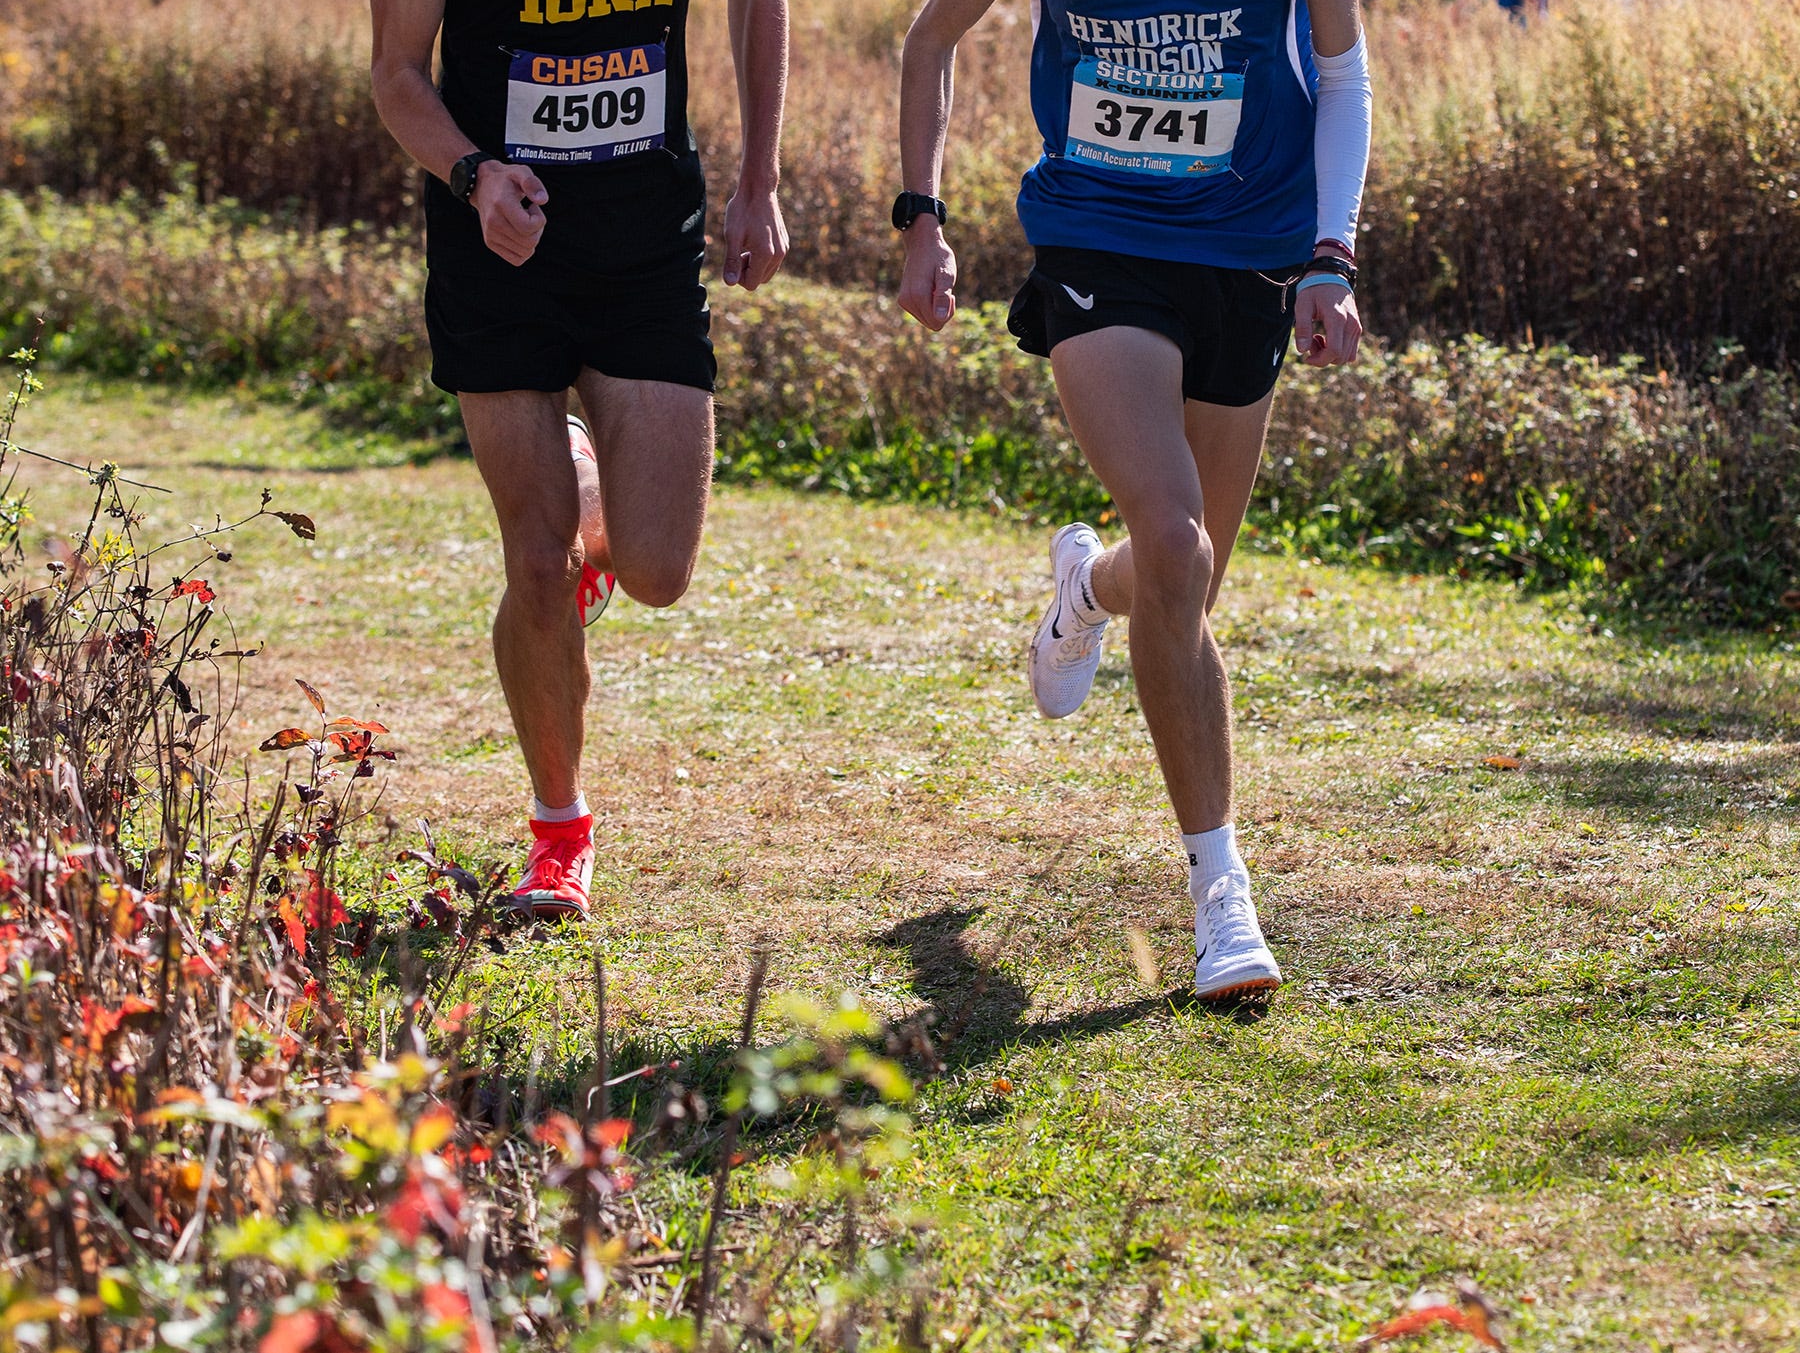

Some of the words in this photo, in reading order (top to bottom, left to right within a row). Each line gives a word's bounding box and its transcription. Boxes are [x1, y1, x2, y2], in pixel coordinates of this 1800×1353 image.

[1066, 8, 1242, 47] HENDRICK
[532, 48, 650, 84] CHSAA
[1096, 60, 1205, 89] SECTION
[1211, 74, 1225, 89] 1
[1095, 77, 1224, 100] X-COUNTRY
[532, 87, 645, 133] 4509
[1094, 99, 1209, 146] 3741
[515, 147, 538, 159] Fulton
[539, 149, 569, 161] Accurate
[569, 149, 592, 161] Timing
[613, 139, 652, 157] FAT.LIVE
[1075, 143, 1102, 161] Fulton
[1102, 151, 1141, 168] Accurate
[1142, 156, 1172, 173] Timing
